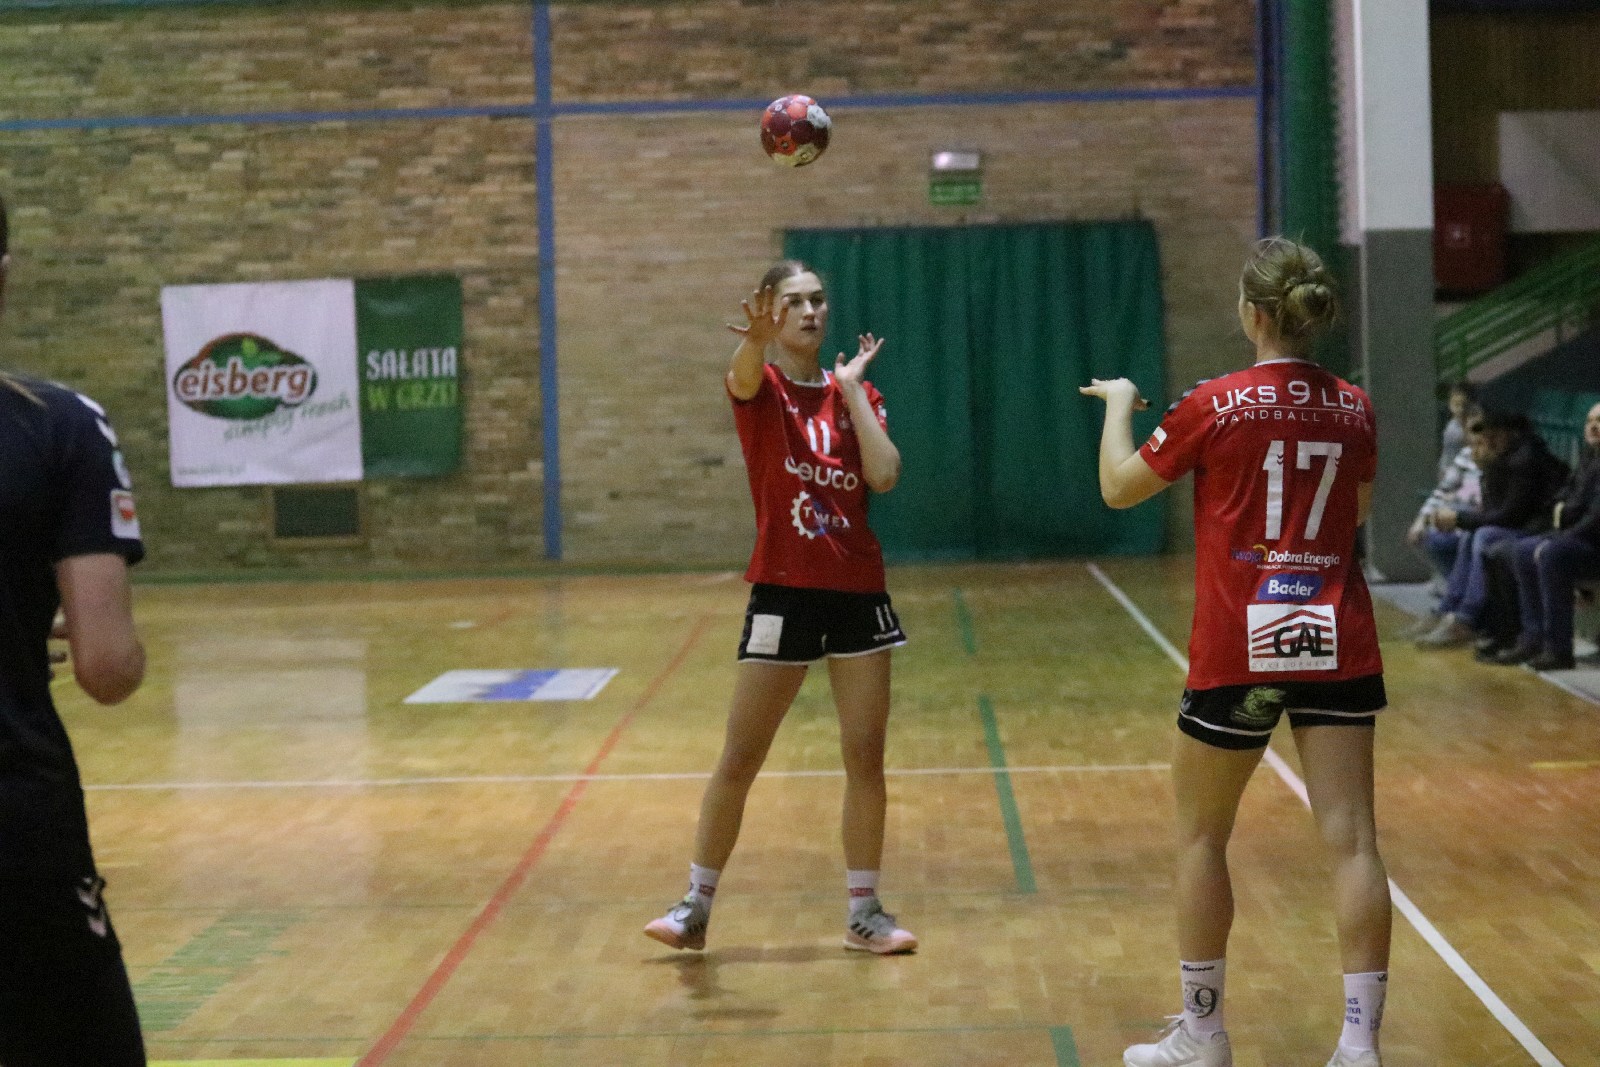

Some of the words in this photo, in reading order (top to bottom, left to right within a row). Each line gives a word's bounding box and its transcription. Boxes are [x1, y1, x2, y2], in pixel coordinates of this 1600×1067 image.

[179, 360, 308, 400] eisberg
[1212, 385, 1277, 413] UKS
[1288, 380, 1311, 405] 9
[1215, 409, 1321, 428] HANDBALL
[807, 417, 831, 456] 11
[1262, 440, 1343, 541] 17
[1268, 550, 1303, 563] Dobra
[1303, 551, 1341, 568] Energia
[1267, 579, 1315, 597] Bacler
[875, 603, 895, 632] 11
[1273, 622, 1335, 659] GAL
